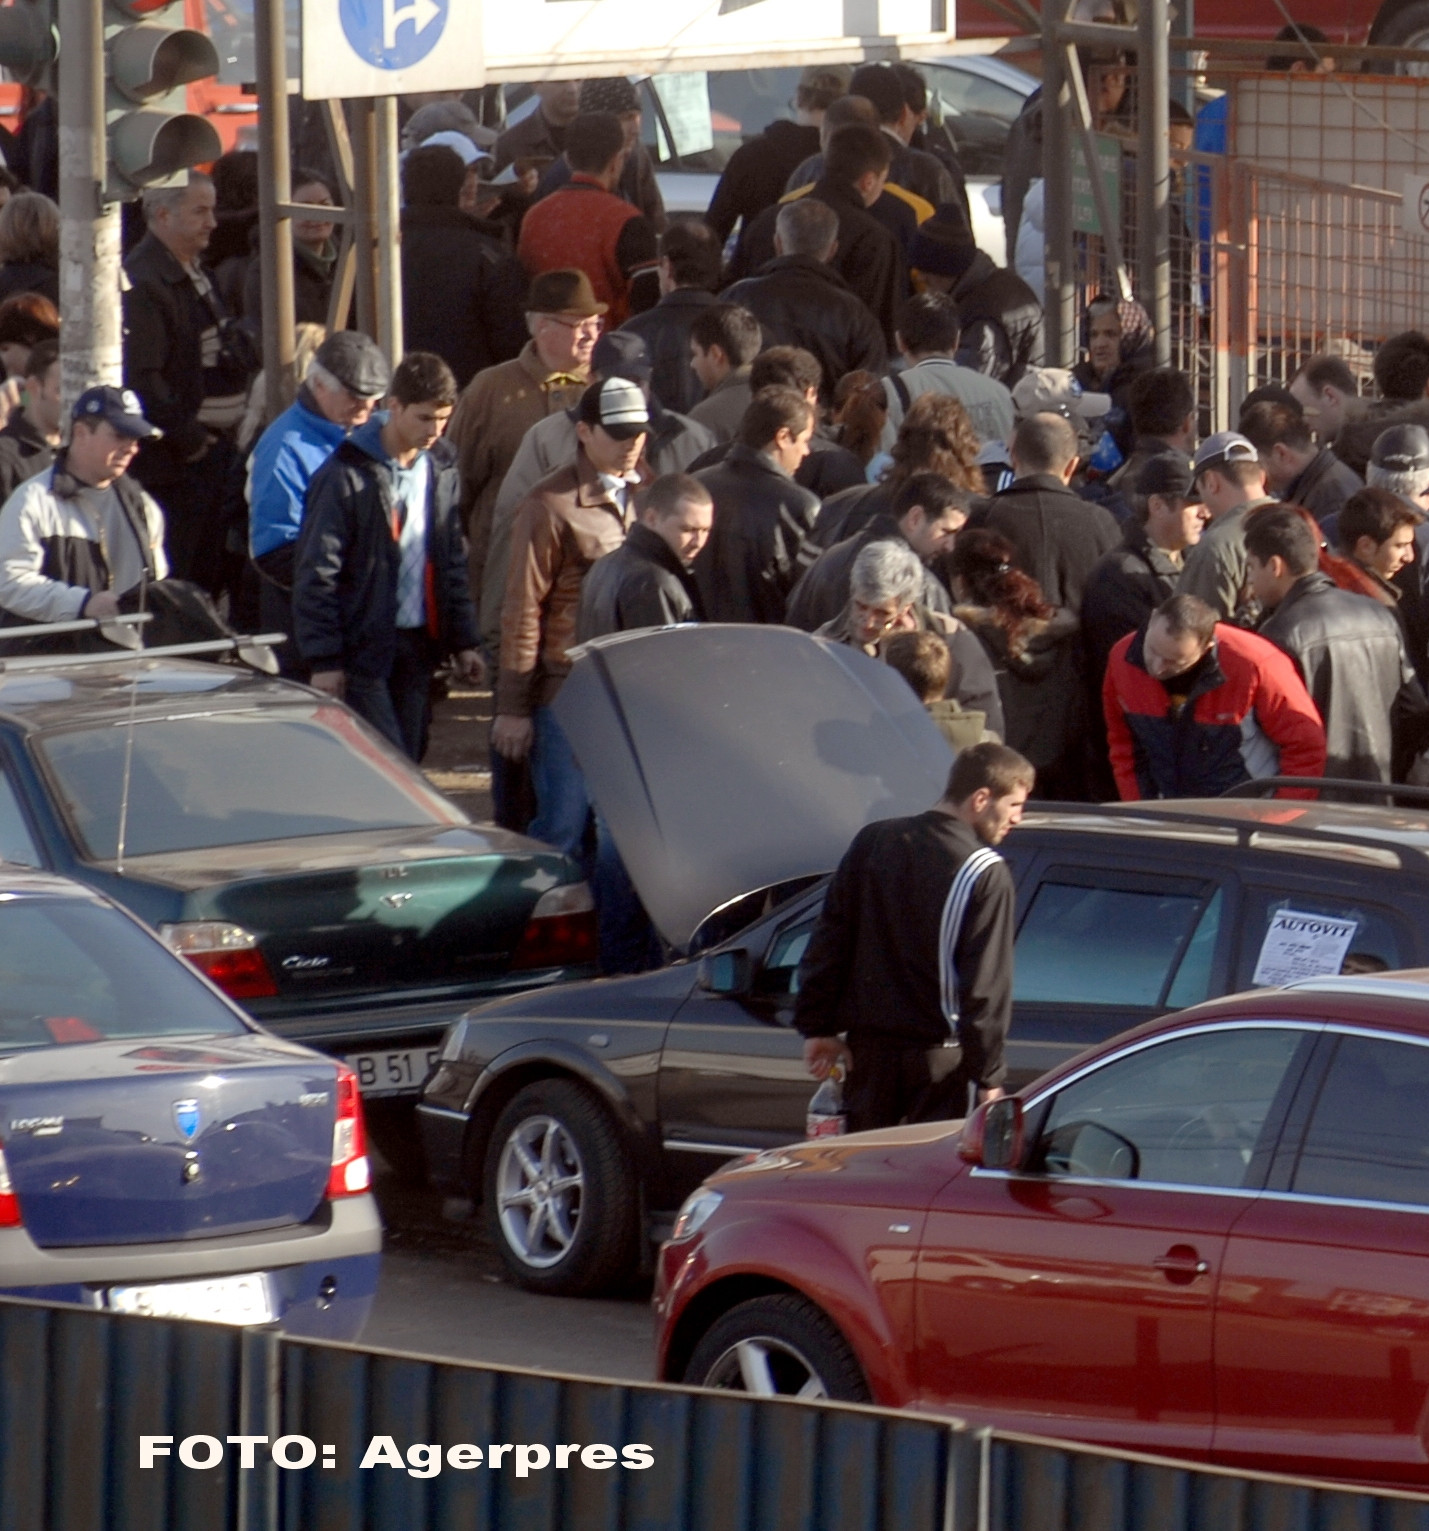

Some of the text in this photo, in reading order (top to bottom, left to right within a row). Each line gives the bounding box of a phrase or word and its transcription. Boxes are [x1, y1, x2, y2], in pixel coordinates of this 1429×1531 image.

[1273, 918, 1350, 937] AUTOVIT
[357, 1056, 376, 1086] B
[386, 1053, 413, 1083] 51
